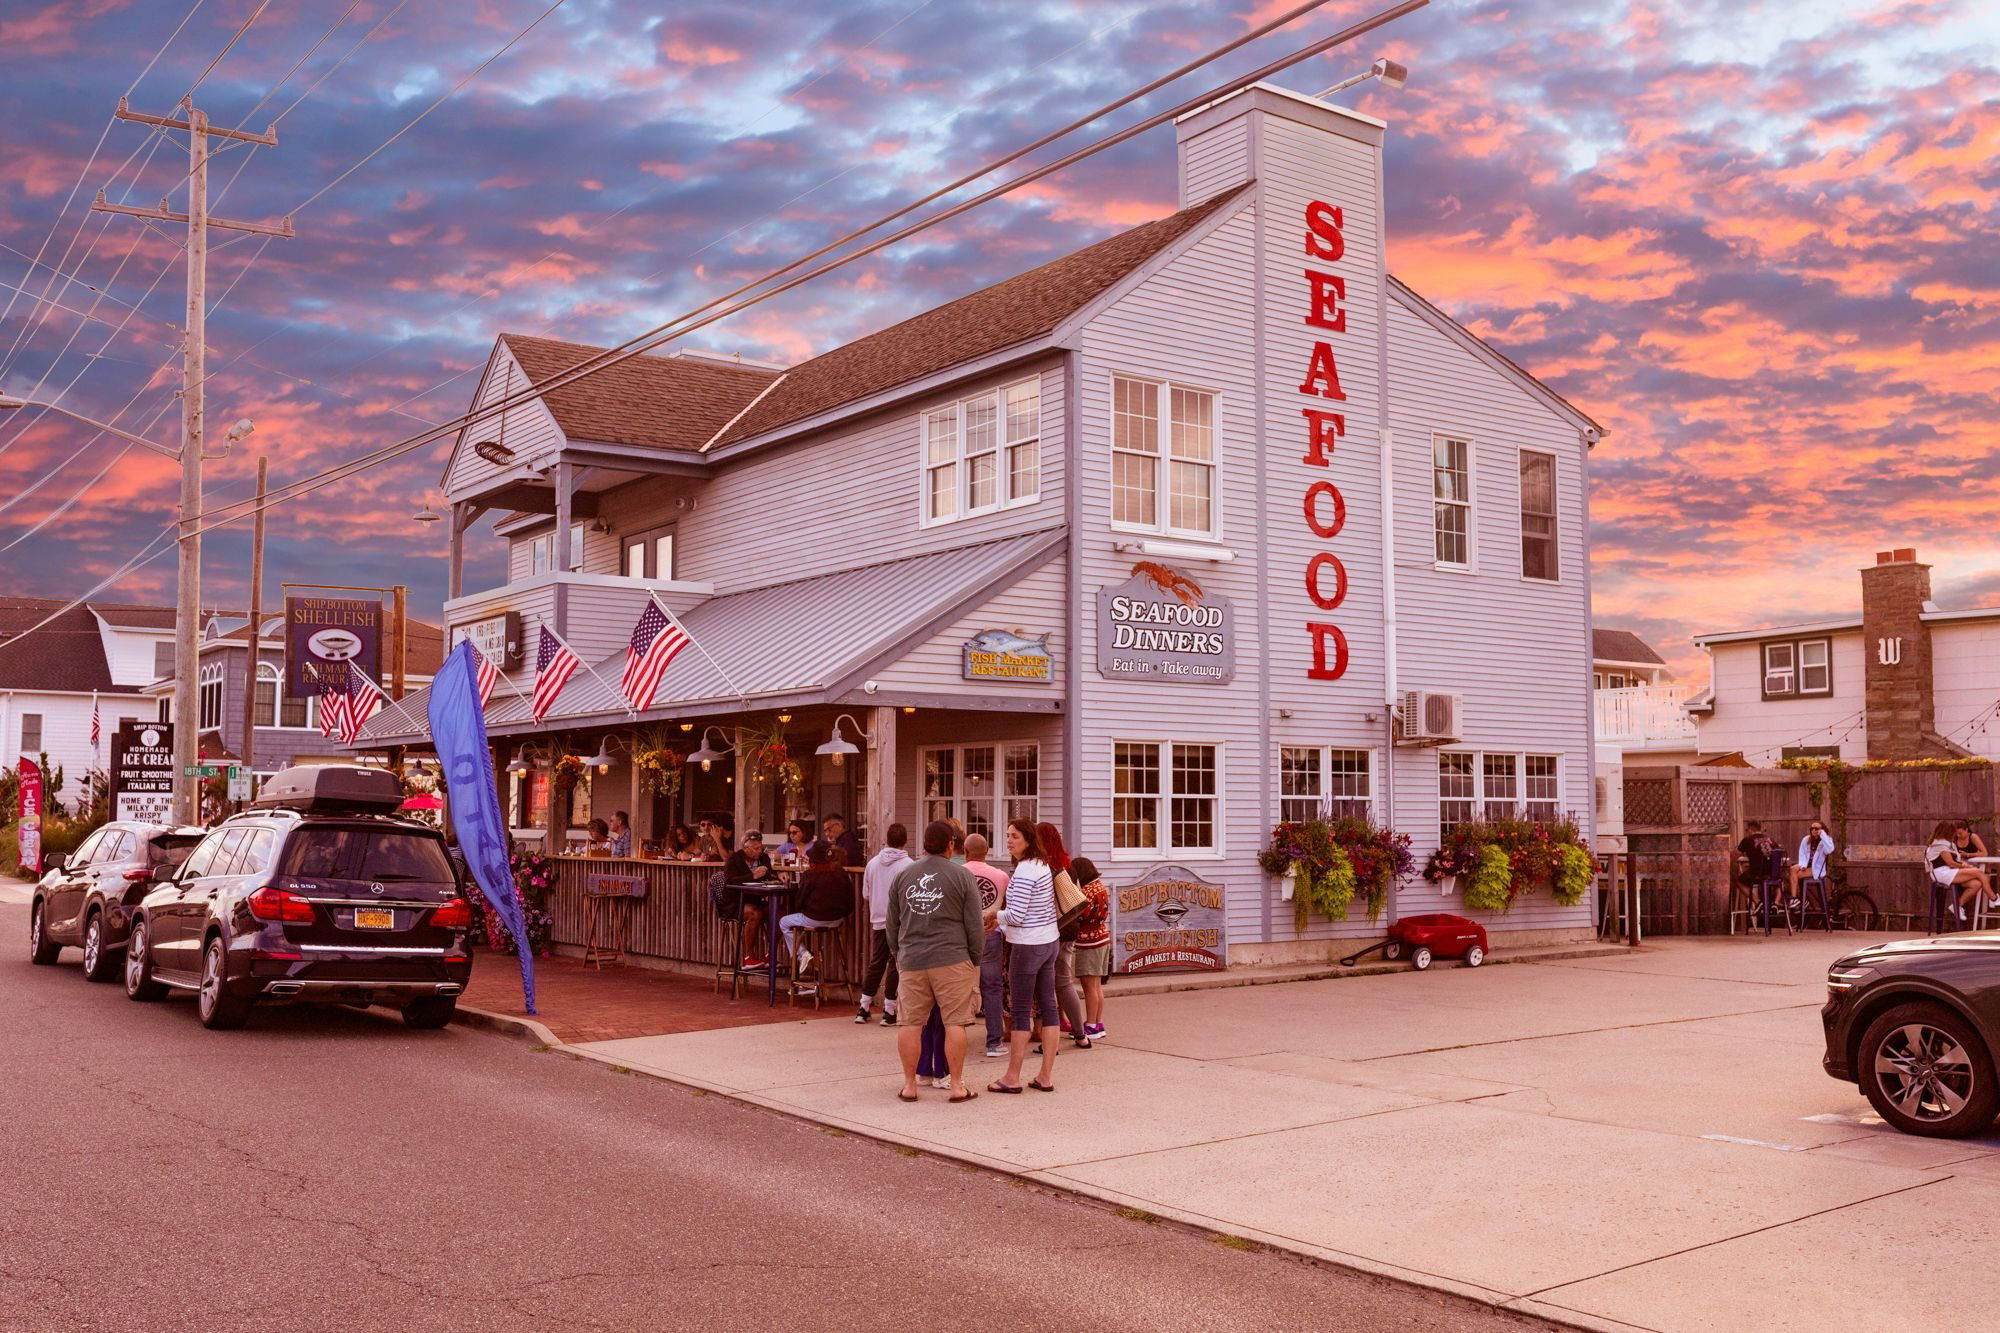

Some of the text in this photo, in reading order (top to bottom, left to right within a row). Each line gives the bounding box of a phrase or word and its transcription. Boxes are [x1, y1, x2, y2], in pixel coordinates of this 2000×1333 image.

[1300, 200, 1349, 681] SEAFOOD
[304, 600, 367, 612] SHIP BOTTOM
[1110, 596, 1223, 628] SEAFOOD
[295, 609, 375, 627] SHELLFISH
[1112, 624, 1223, 655] DINNERS
[302, 664, 368, 673] FH MART
[970, 652, 1048, 667] FISH MARKET
[1112, 658, 1223, 679] Eat in Take away
[972, 664, 1048, 678] RESTAURANT
[122, 753, 140, 765] ICE
[120, 770, 140, 778] FRUIT
[184, 767, 218, 776] 18TH ST
[21, 789, 37, 866] ICE CREAM
[1120, 881, 1222, 913] SHIP BOTTOM
[1125, 929, 1218, 952] SHELLFISH
[1128, 958, 1144, 972] FISH
[1145, 952, 1170, 966] MARKET
[1177, 952, 1216, 968] RESTAURANT
